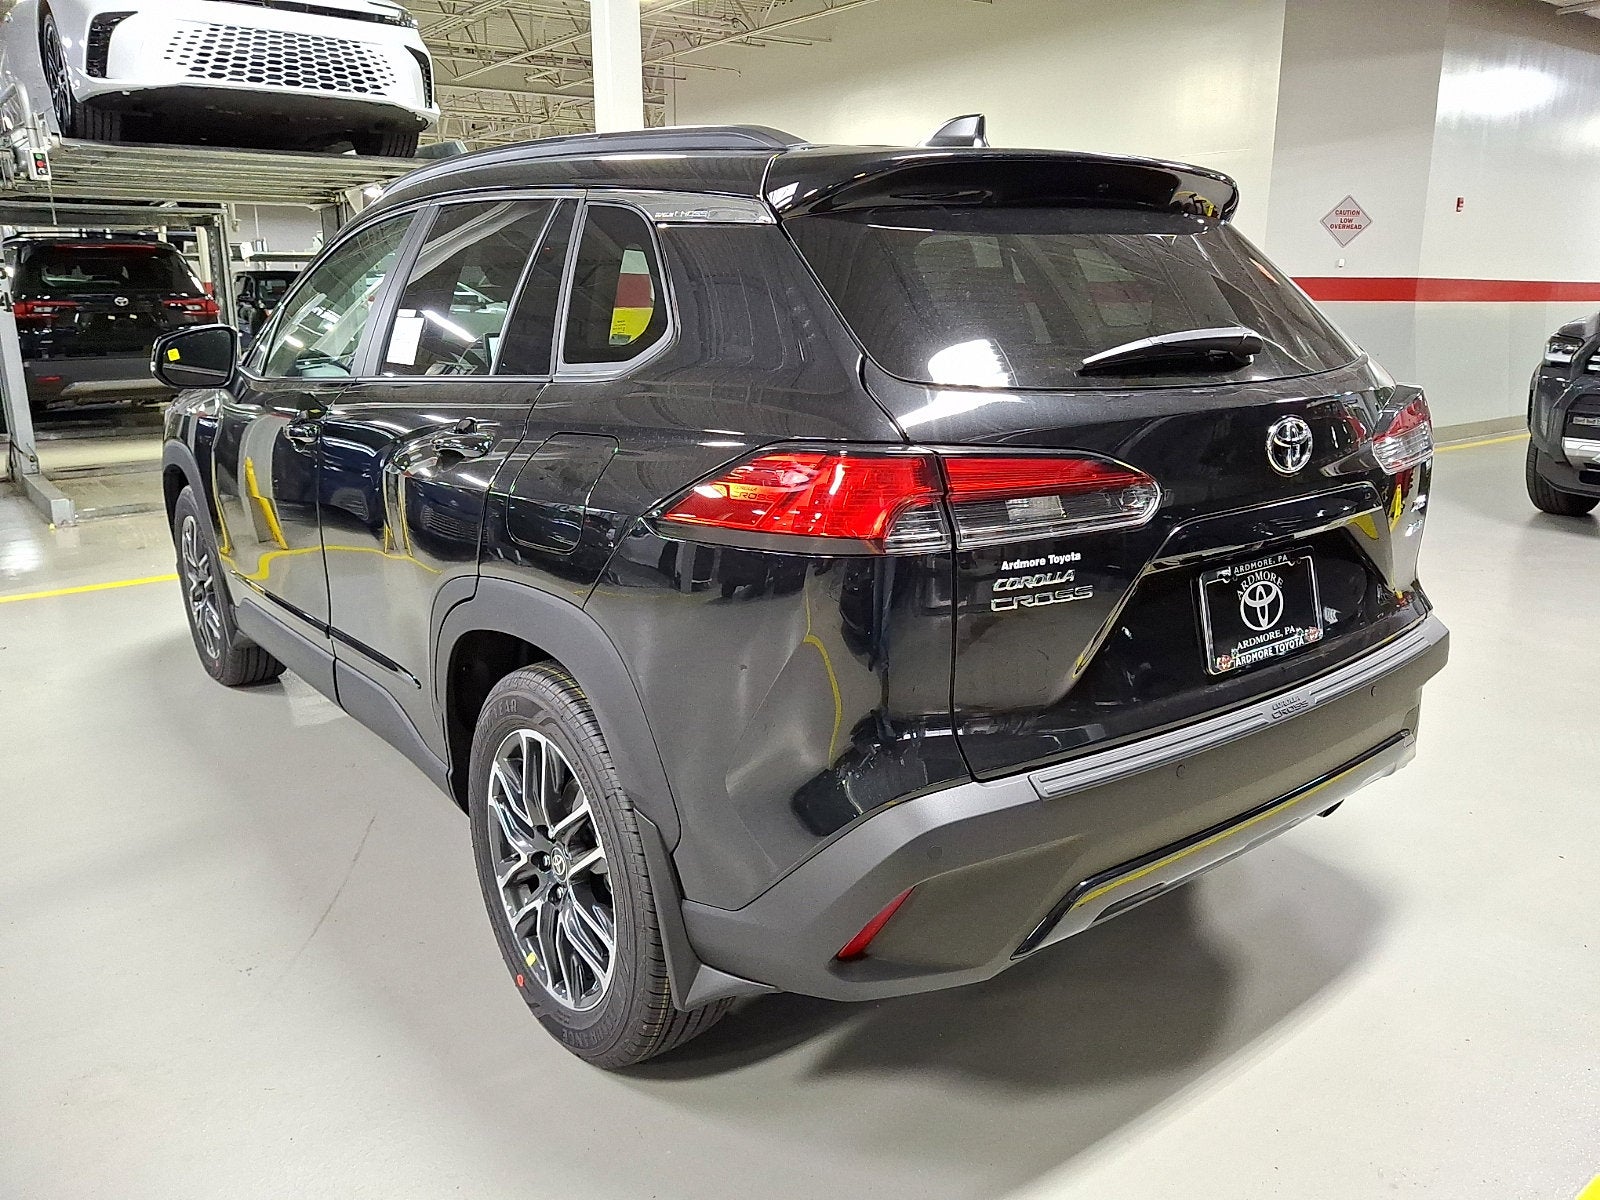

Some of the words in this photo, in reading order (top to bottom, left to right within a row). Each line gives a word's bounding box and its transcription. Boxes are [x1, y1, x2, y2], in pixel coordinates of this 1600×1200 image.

[1001, 559, 1046, 571] Ardmore
[1047, 551, 1082, 565] Toyota
[1277, 554, 1288, 562] PA
[992, 569, 1076, 592] COROLLA
[1236, 570, 1284, 600] ARDMORE
[990, 584, 1094, 612] CROSS
[1236, 629, 1284, 651] ARDMORE,
[1284, 625, 1296, 635] PA
[1235, 650, 1274, 667] ARDMORE
[1274, 637, 1305, 656] TOYOTA
[1271, 700, 1309, 719] CROSS
